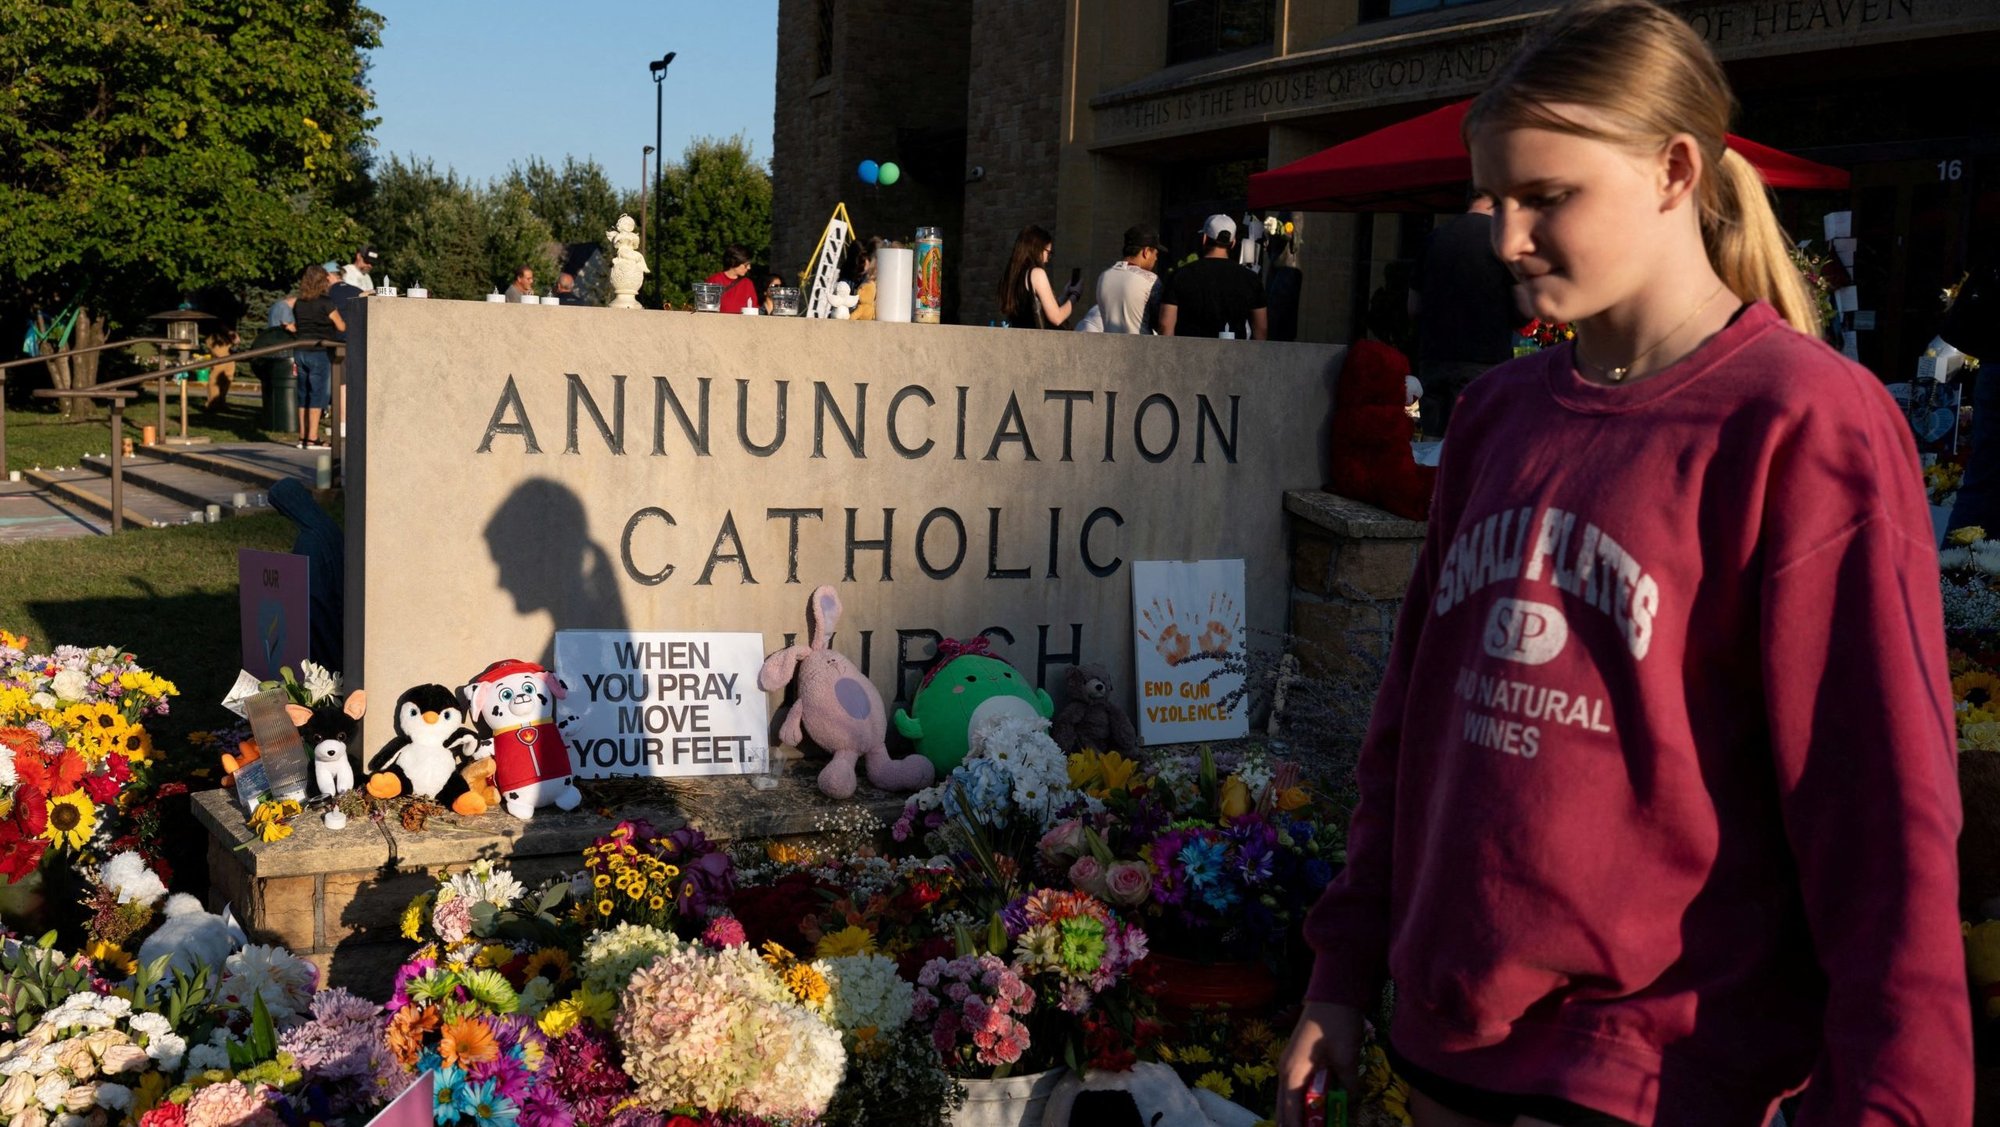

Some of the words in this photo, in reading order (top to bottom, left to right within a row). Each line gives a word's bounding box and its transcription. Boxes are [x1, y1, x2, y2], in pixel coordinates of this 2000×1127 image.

[1135, 101, 1170, 128] THIS
[1177, 97, 1191, 120] IS
[1200, 88, 1234, 116] THE
[1244, 76, 1316, 108] HOUSE
[1327, 66, 1358, 95] OF
[1368, 58, 1425, 89] GOD
[1437, 45, 1498, 78] AND
[1937, 159, 1962, 181] 16
[476, 373, 1241, 465] ANNUNCIATION
[621, 505, 1125, 587] CATHOLIC
[262, 568, 280, 589] OUR
[1525, 507, 1659, 661] PLATES
[1492, 607, 1547, 653] SP
[614, 642, 710, 669] WHEN
[583, 674, 649, 702] YOU
[657, 673, 742, 705] PRAY,
[1145, 682, 1173, 696] END
[1180, 682, 1210, 699] GUN
[1477, 674, 1611, 733] NATURAL
[618, 705, 711, 734] MOVE
[1463, 709, 1541, 759] WINES
[572, 738, 664, 768] YOUR
[672, 736, 752, 765] FEET.
